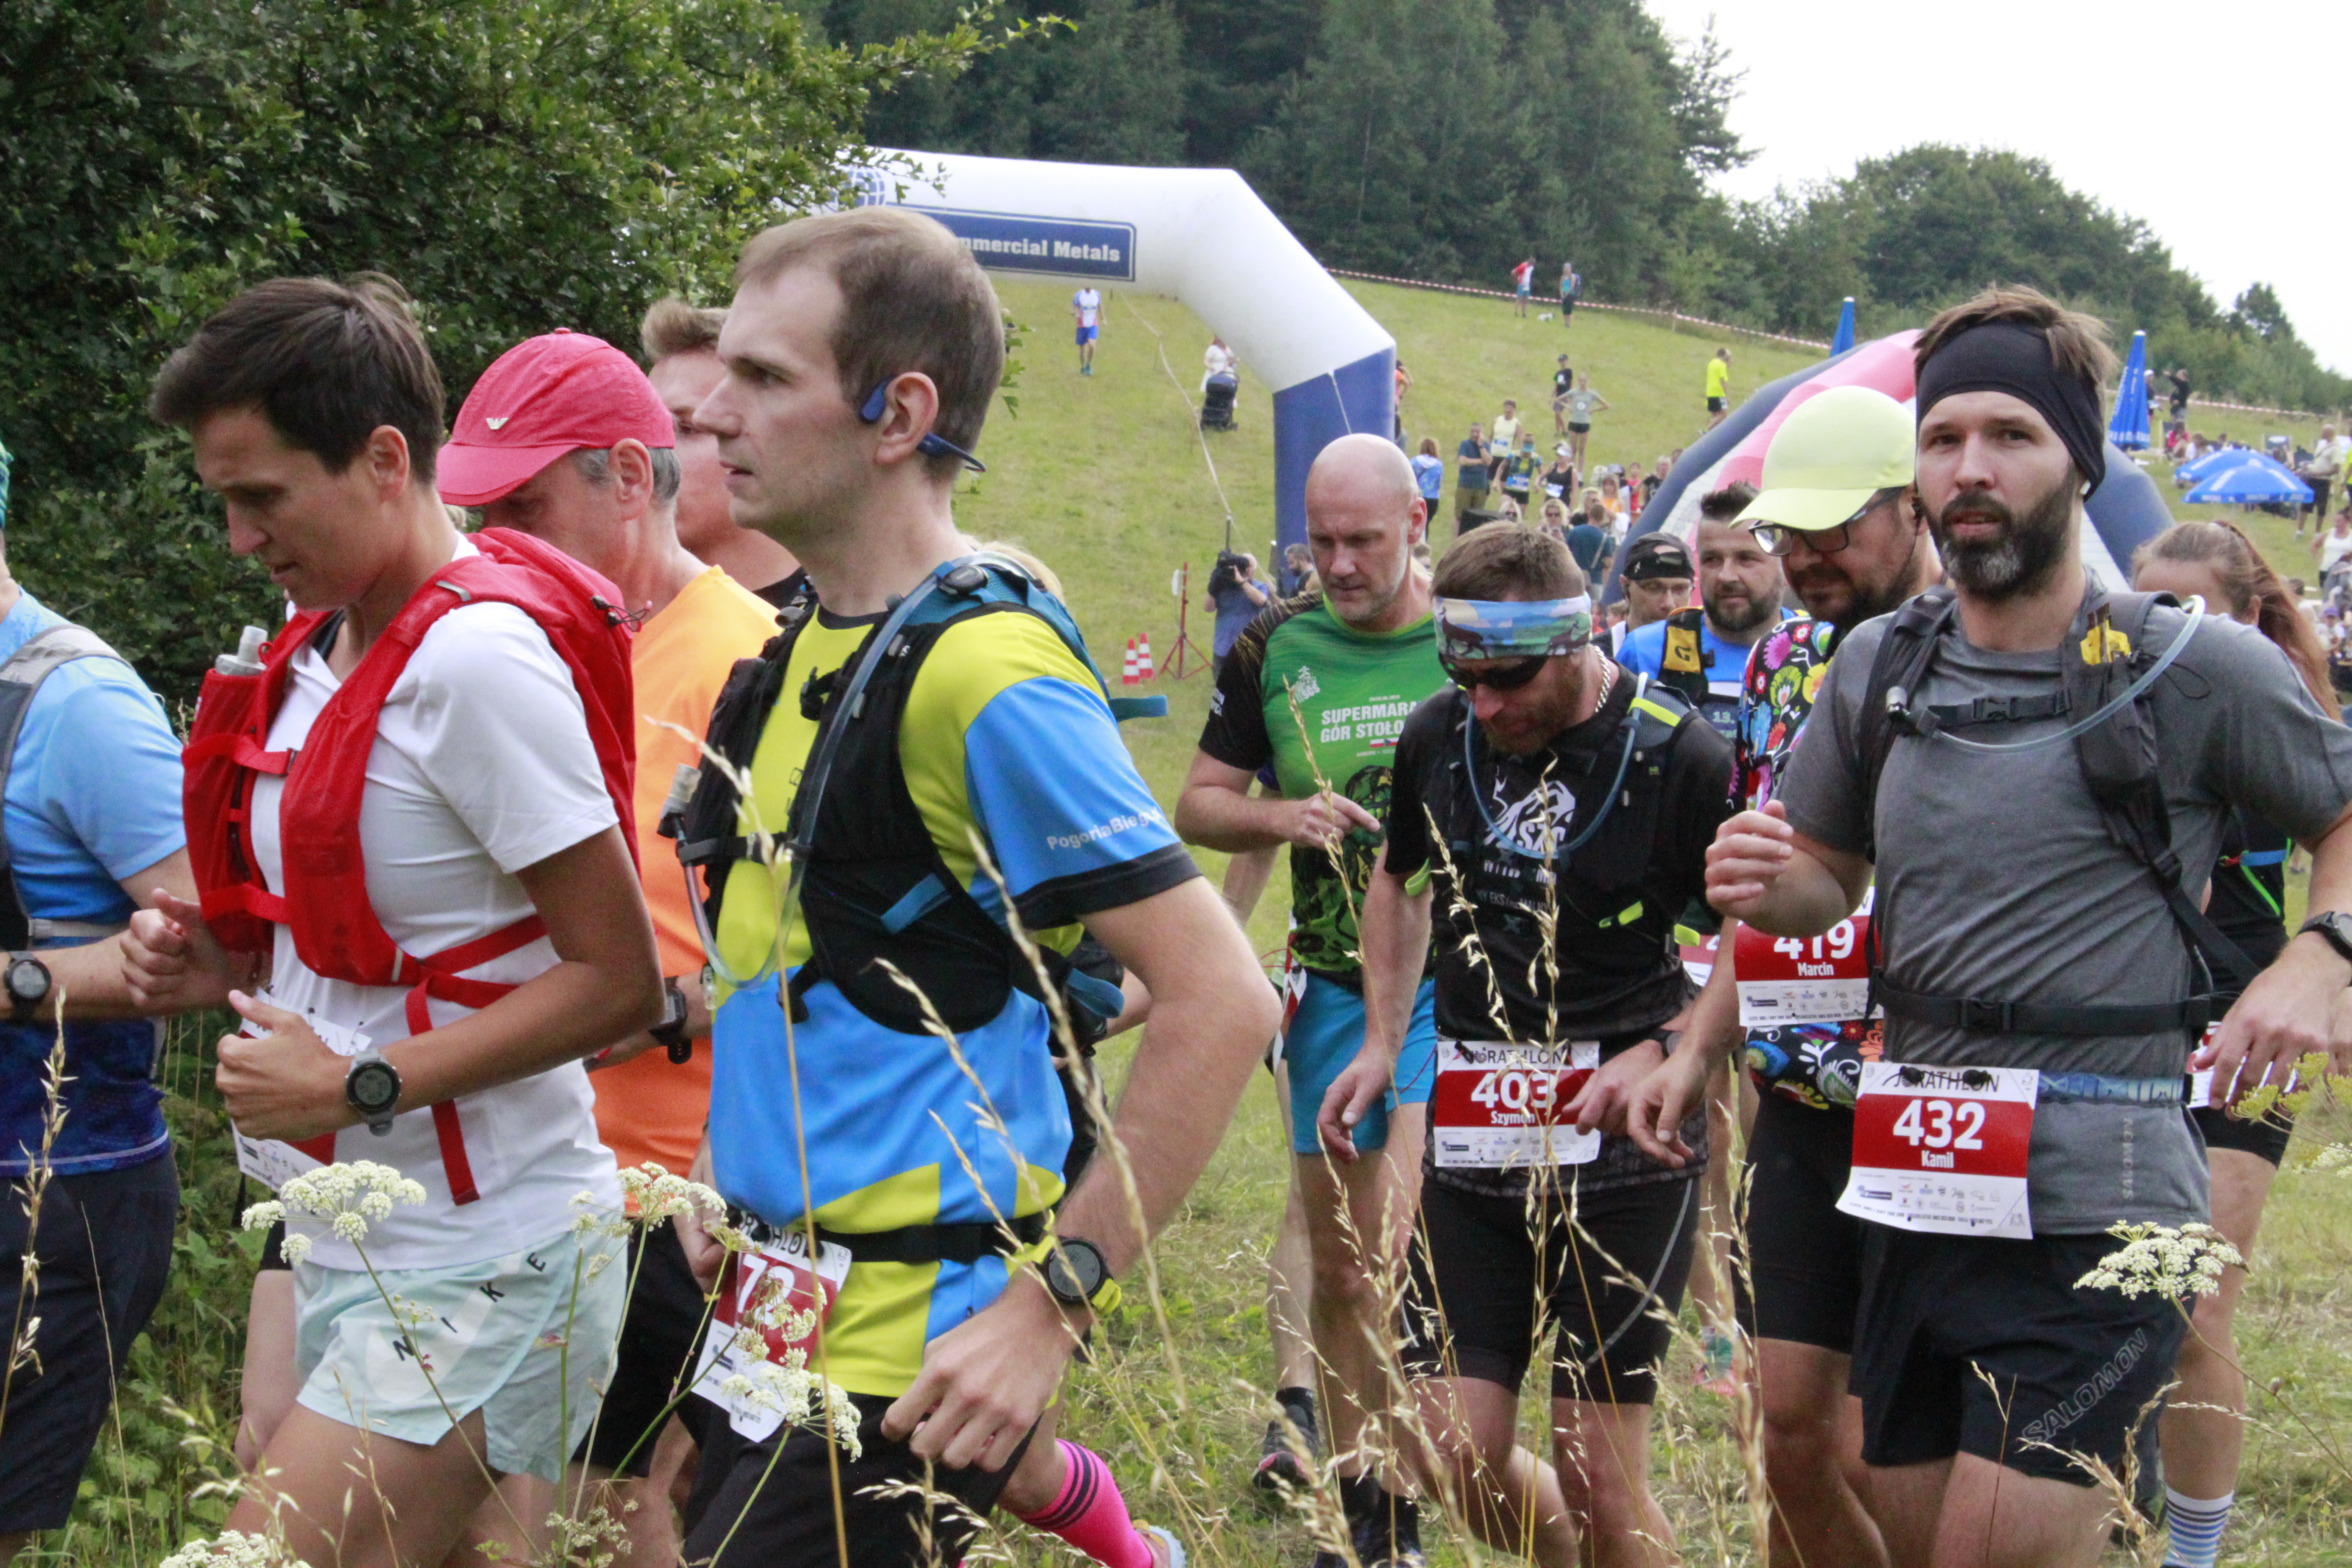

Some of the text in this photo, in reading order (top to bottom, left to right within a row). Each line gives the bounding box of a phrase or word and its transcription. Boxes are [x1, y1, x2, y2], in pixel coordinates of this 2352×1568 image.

[1053, 241, 1121, 262] Metals
[1321, 723, 1351, 743] GÓR
[1774, 919, 1855, 959] 419
[1797, 962, 1834, 977] Marcin
[1471, 1072, 1558, 1109] 403
[1893, 1099, 1985, 1150] 432
[1921, 1150, 1954, 1169] Kamil
[393, 1252, 546, 1361] NIKE
[2022, 1327, 2148, 1450] SALOMON
